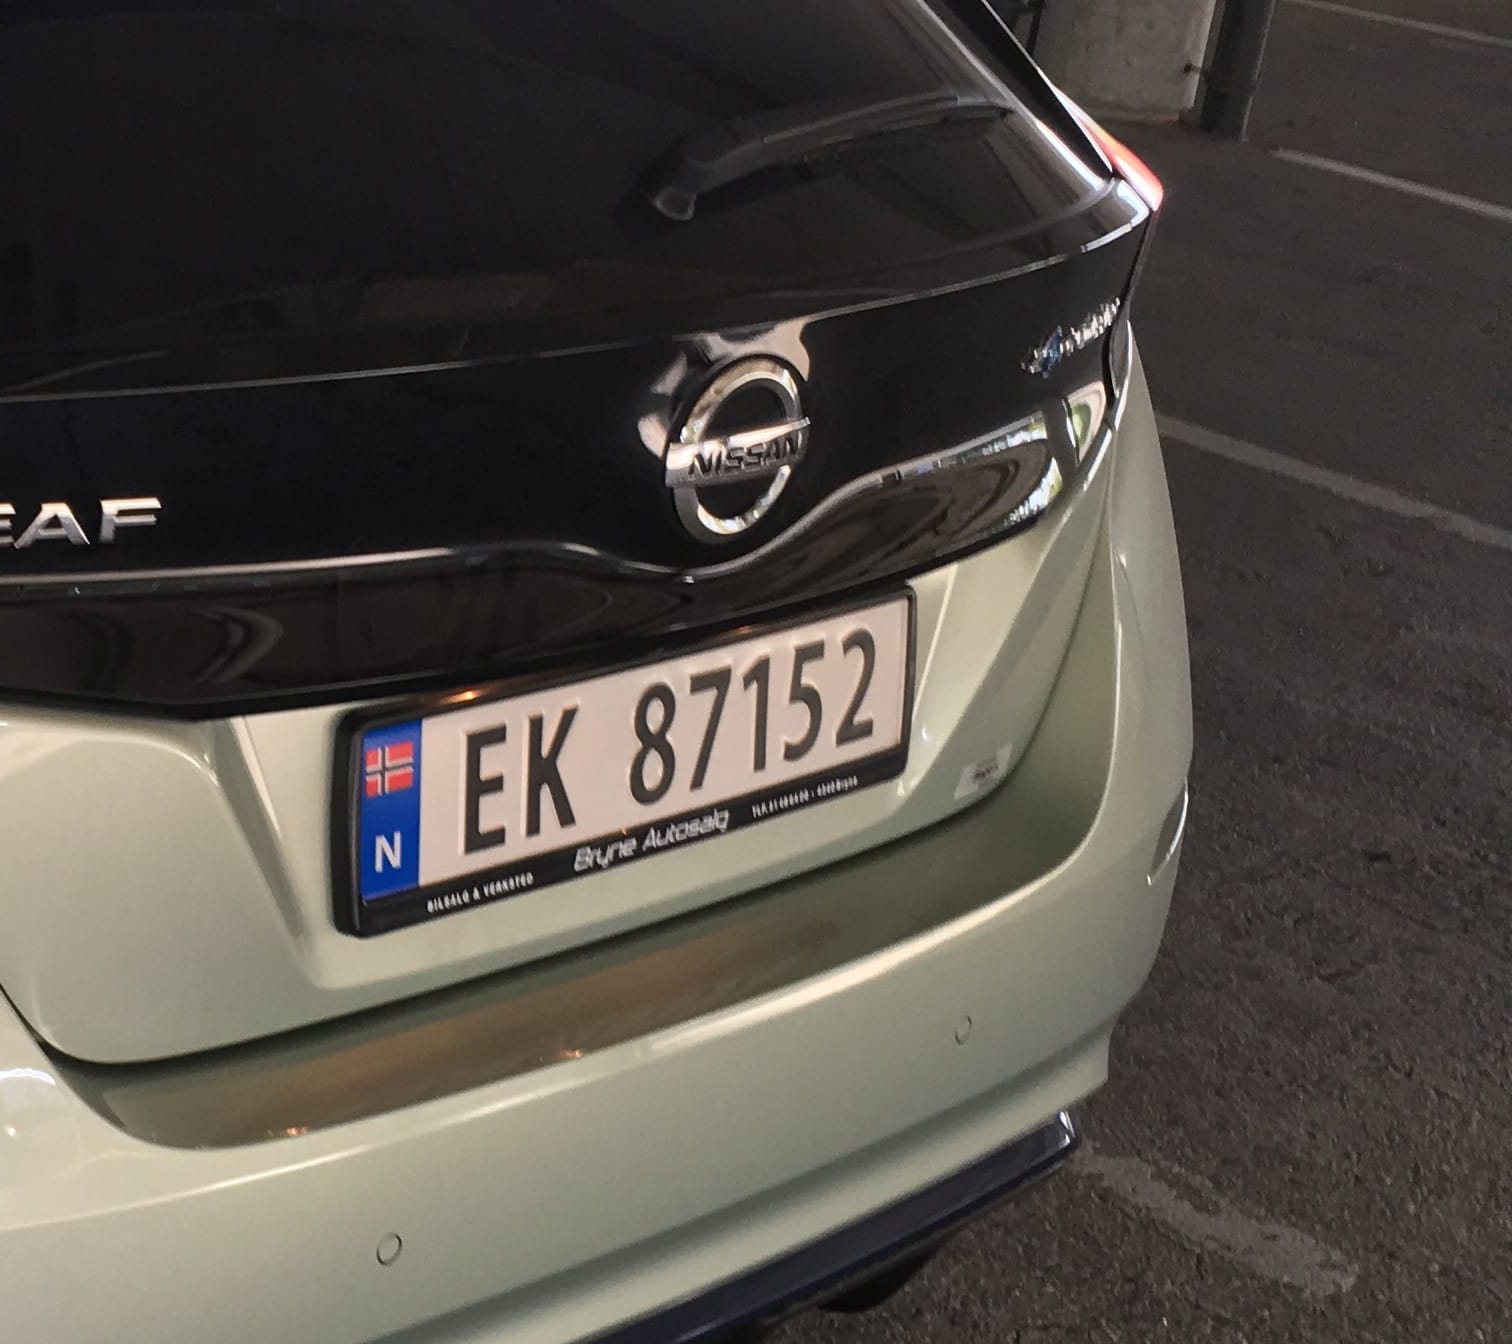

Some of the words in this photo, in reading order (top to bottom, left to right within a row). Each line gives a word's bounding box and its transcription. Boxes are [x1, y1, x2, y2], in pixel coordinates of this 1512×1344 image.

[687, 437, 800, 481] NISSAN
[462, 703, 579, 855] EK
[629, 627, 877, 805] 87152
[374, 830, 402, 874] N
[573, 836, 638, 873] Bryne
[641, 807, 730, 852] Autosalg
